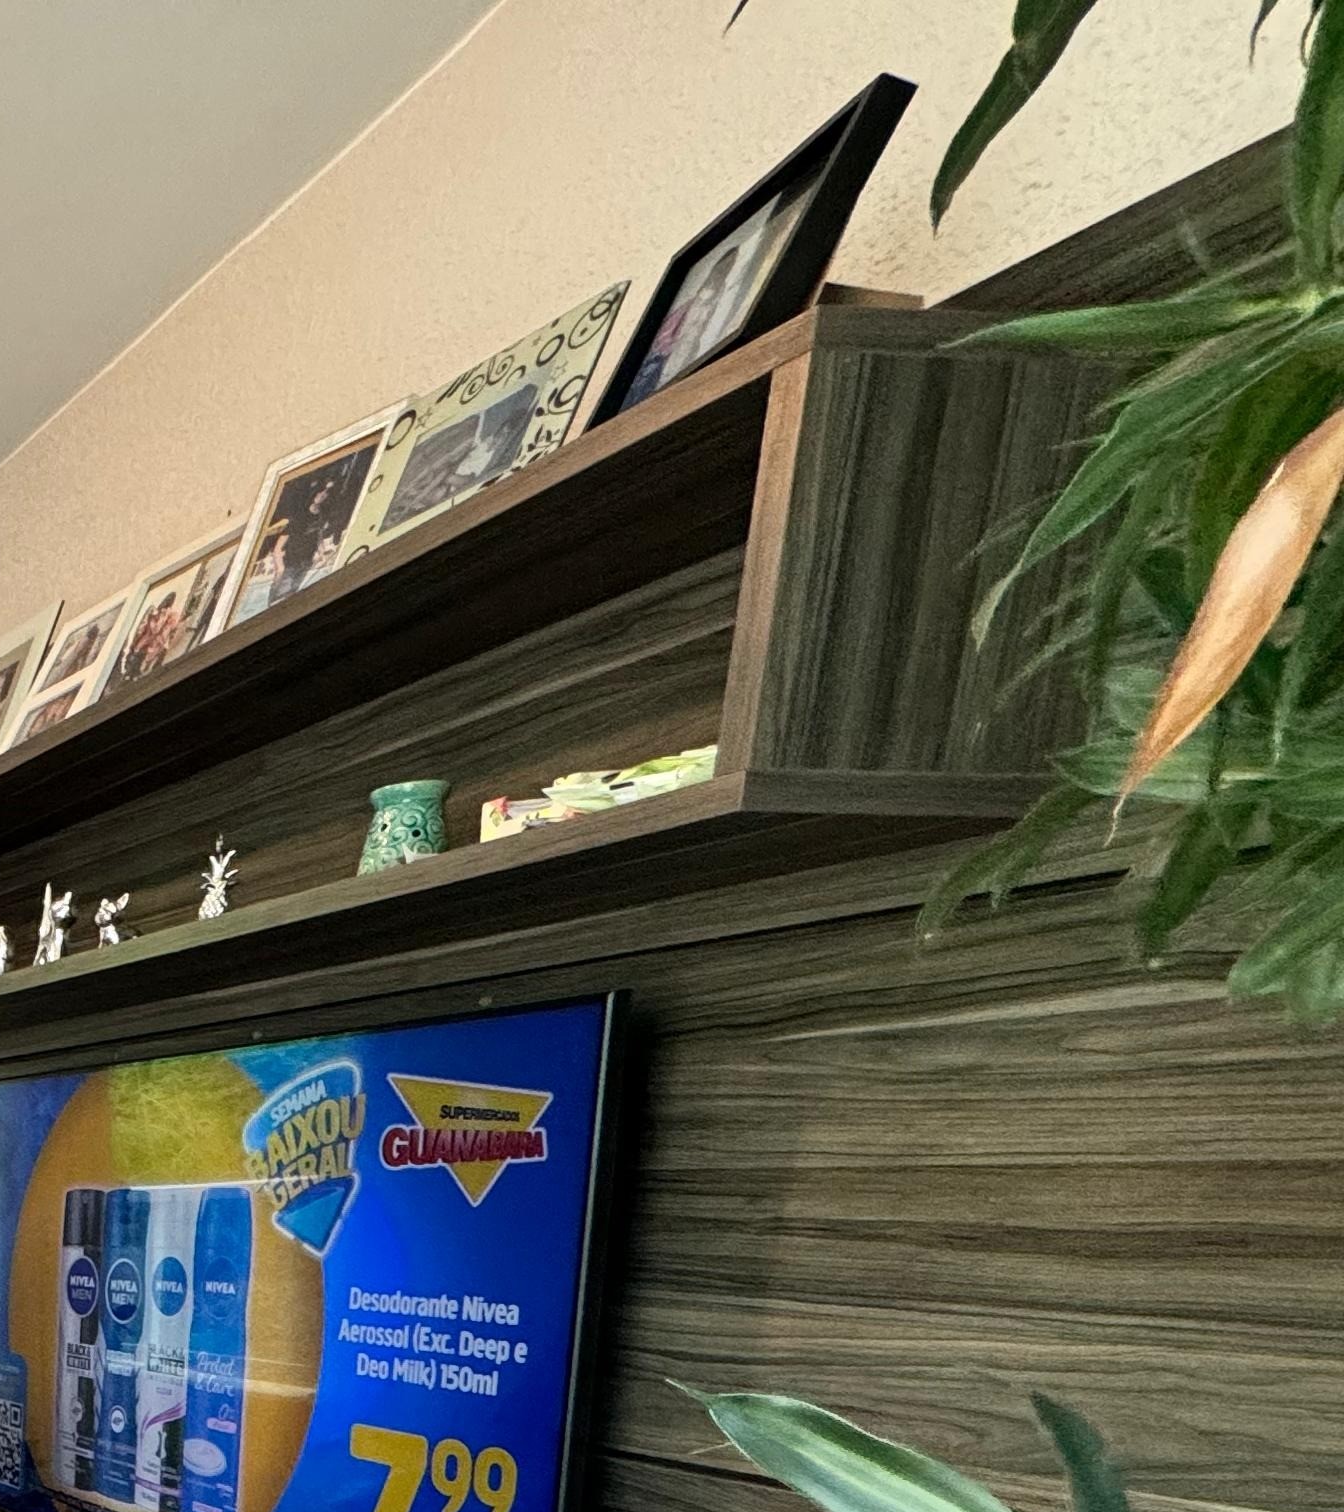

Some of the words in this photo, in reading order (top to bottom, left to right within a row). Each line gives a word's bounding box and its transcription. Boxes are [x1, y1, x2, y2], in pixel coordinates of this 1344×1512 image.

[270, 1079, 328, 1127] SEMANA
[245, 1094, 366, 1193] BAIXOU
[382, 1126, 544, 1168] GUANABARA
[272, 1142, 353, 1208] GERAL
[70, 1275, 95, 1288] NIVEA
[110, 1279, 138, 1293] NIVEA
[155, 1280, 183, 1293] NIVEA
[205, 1281, 236, 1295] NIVEA
[349, 1286, 459, 1320] Desodorante
[462, 1295, 520, 1325] Nivea
[338, 1318, 410, 1349] Aerossol
[412, 1322, 455, 1355] (Exc.
[459, 1330, 510, 1365] Deep
[514, 1341, 528, 1364] e
[356, 1353, 389, 1379] Deo
[392, 1357, 437, 1390] Milk)
[440, 1363, 499, 1396] 150ml
